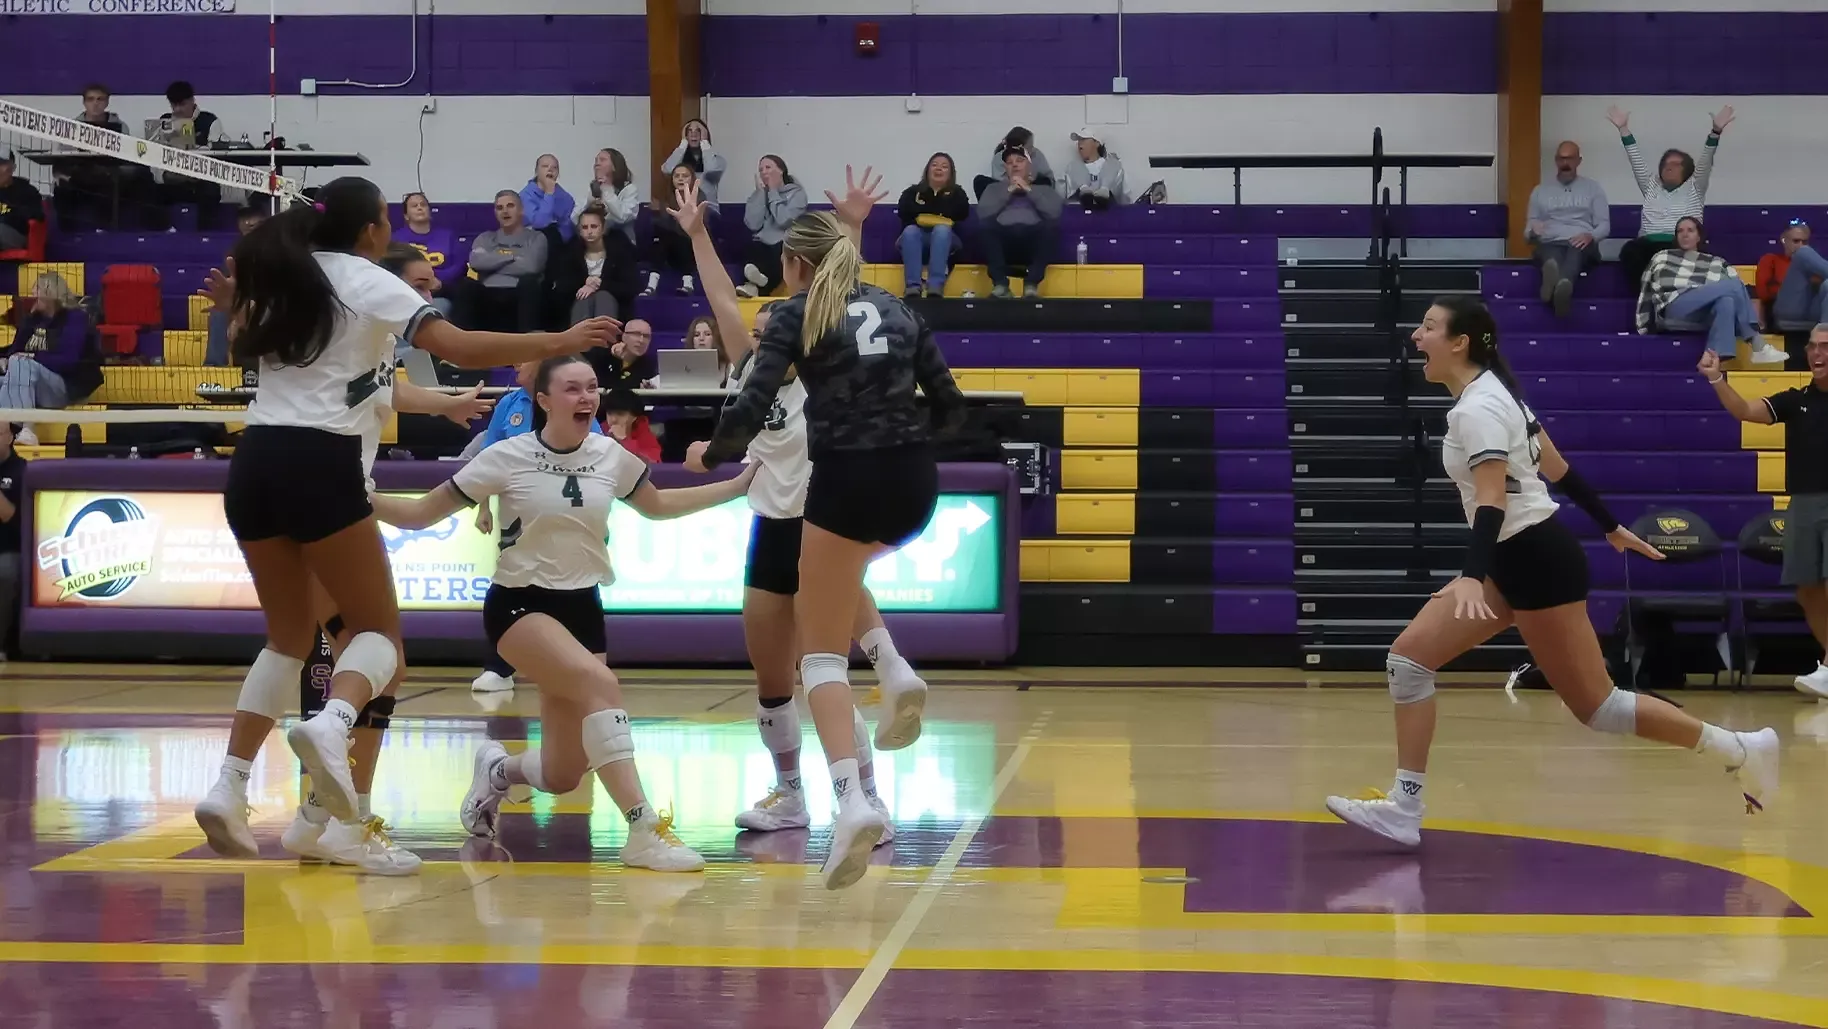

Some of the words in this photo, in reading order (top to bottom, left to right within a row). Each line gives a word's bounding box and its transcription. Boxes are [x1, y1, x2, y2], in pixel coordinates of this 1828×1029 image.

[88, 0, 227, 13] CONFERENCE
[49, 116, 78, 140] POINT
[79, 126, 121, 152] POINTERS
[162, 147, 208, 175] UW-STEVENS
[209, 161, 231, 181] POINT
[231, 166, 264, 187] POINTERS
[847, 301, 889, 356] 2
[562, 475, 583, 507] 4
[67, 573, 96, 592] AUTO
[98, 561, 148, 579] SERVICE
[432, 563, 477, 572] POINT
